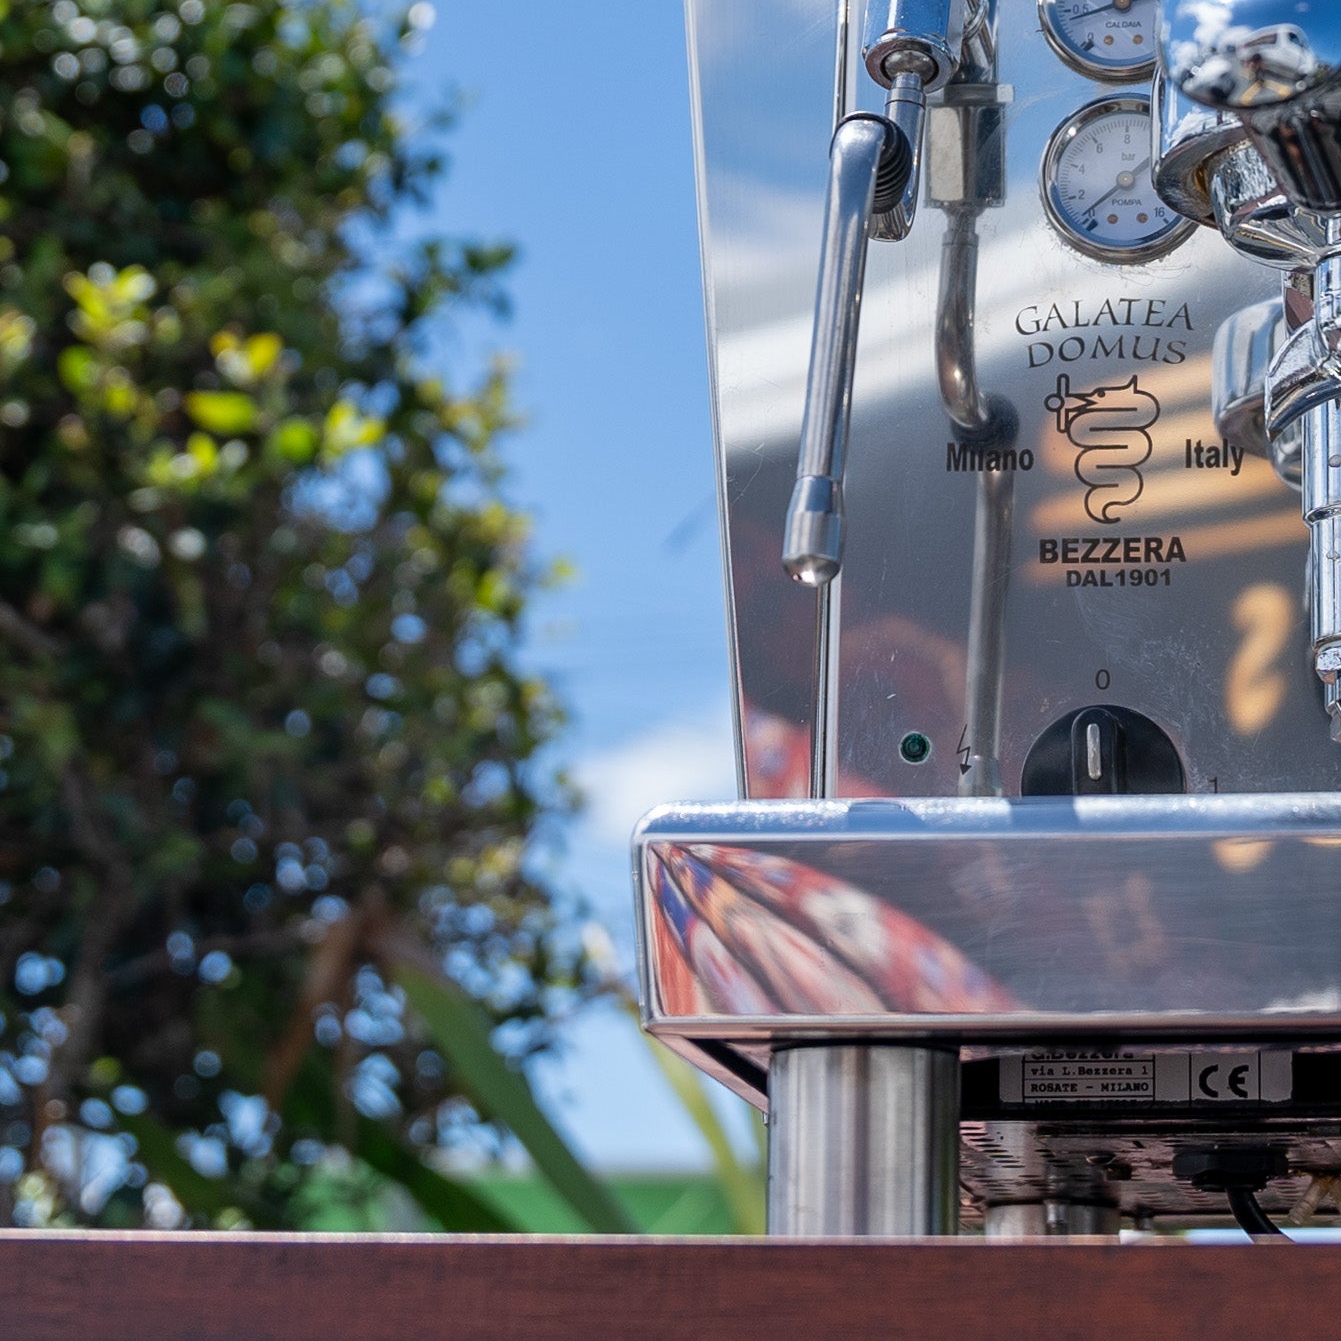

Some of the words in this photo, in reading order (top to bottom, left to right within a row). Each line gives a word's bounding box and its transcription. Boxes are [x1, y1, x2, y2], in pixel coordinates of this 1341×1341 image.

[1105, 20, 1142, 28] CALDAIA
[1123, 133, 1131, 144] 8
[1096, 143, 1104, 154] 6
[1121, 152, 1136, 161] bar
[1078, 164, 1086, 175] 4
[1078, 189, 1086, 200] 2
[1111, 198, 1142, 206] POMPA
[1154, 206, 1166, 218] 16
[1015, 298, 1194, 335] GALATEA
[1028, 335, 1187, 368] DOMUS
[946, 442, 1035, 472] Milano
[1185, 439, 1245, 476] Italy
[1039, 536, 1187, 563] BEZZERA
[1066, 568, 1171, 587] DAL1901
[1031, 1065, 1054, 1076] via
[1062, 1066, 1133, 1076] L.Bezzera
[1199, 1064, 1249, 1098] CE
[1030, 1083, 1078, 1092] ROSATE
[1101, 1082, 1149, 1092] MILANO
